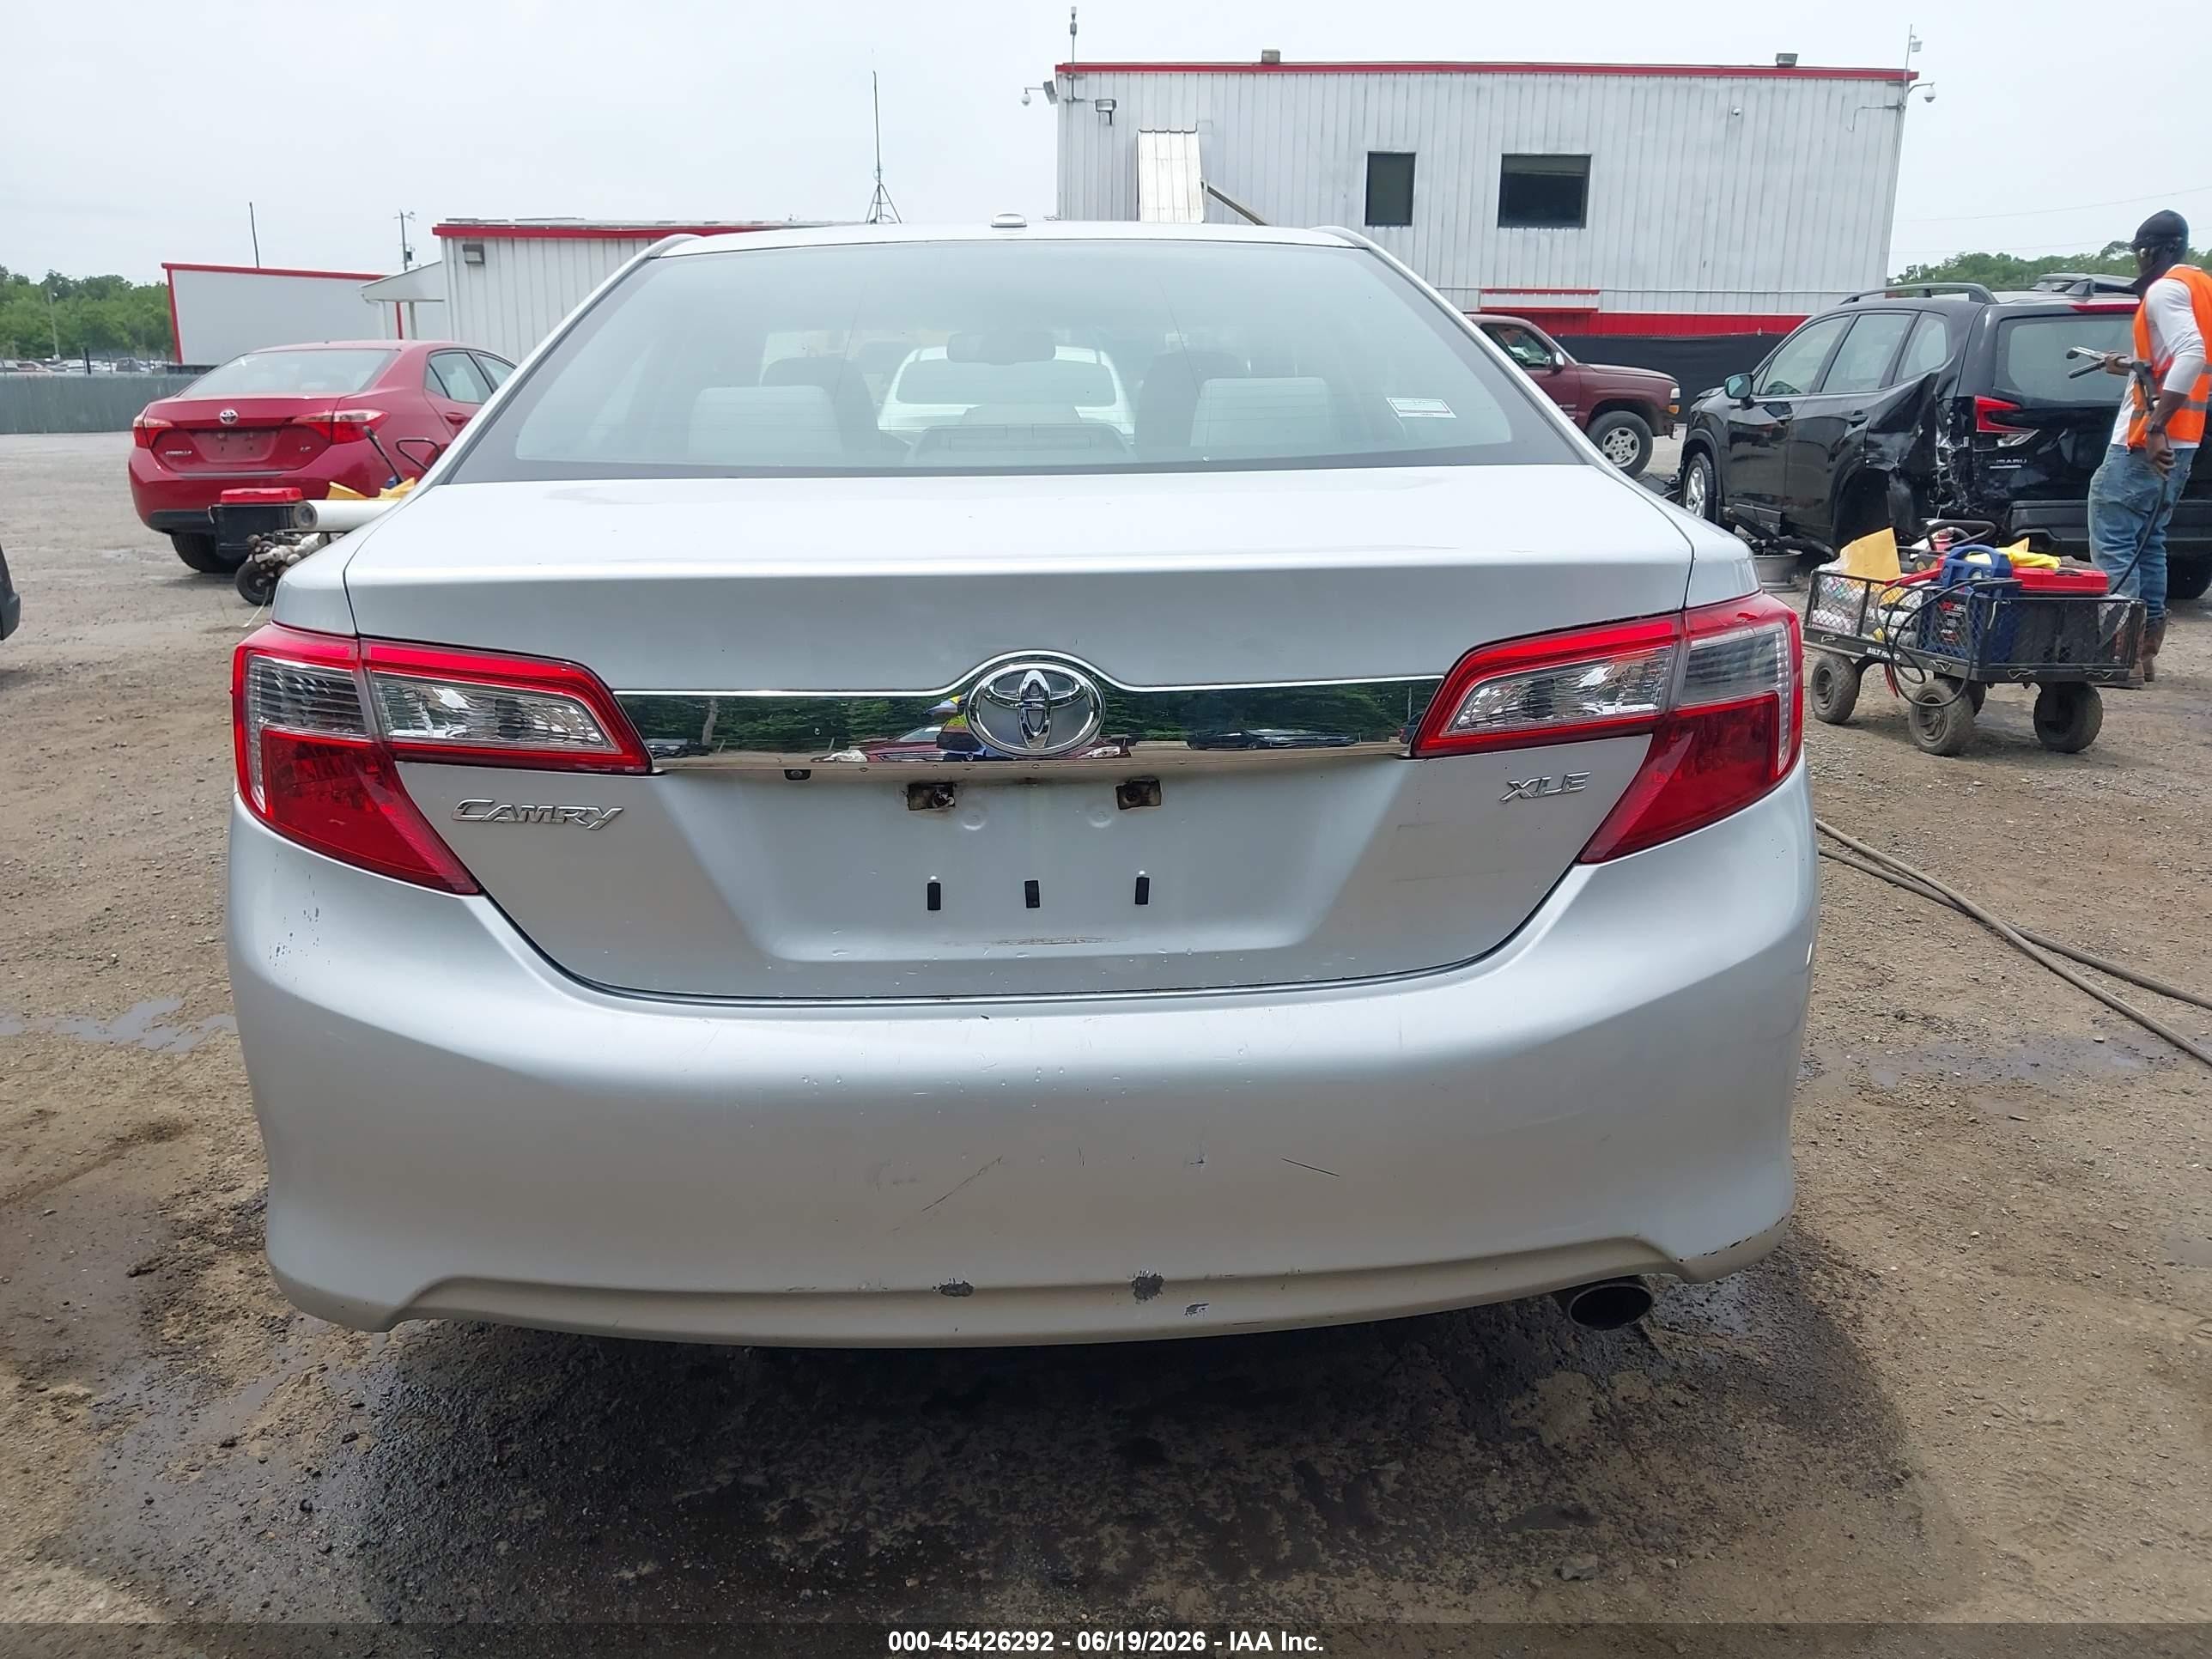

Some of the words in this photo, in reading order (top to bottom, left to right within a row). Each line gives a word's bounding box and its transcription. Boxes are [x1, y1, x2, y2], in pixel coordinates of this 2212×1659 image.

[1866, 647, 1881, 656] BILT
[1499, 771, 1590, 804] XLE
[453, 799, 624, 830] CAMRY
